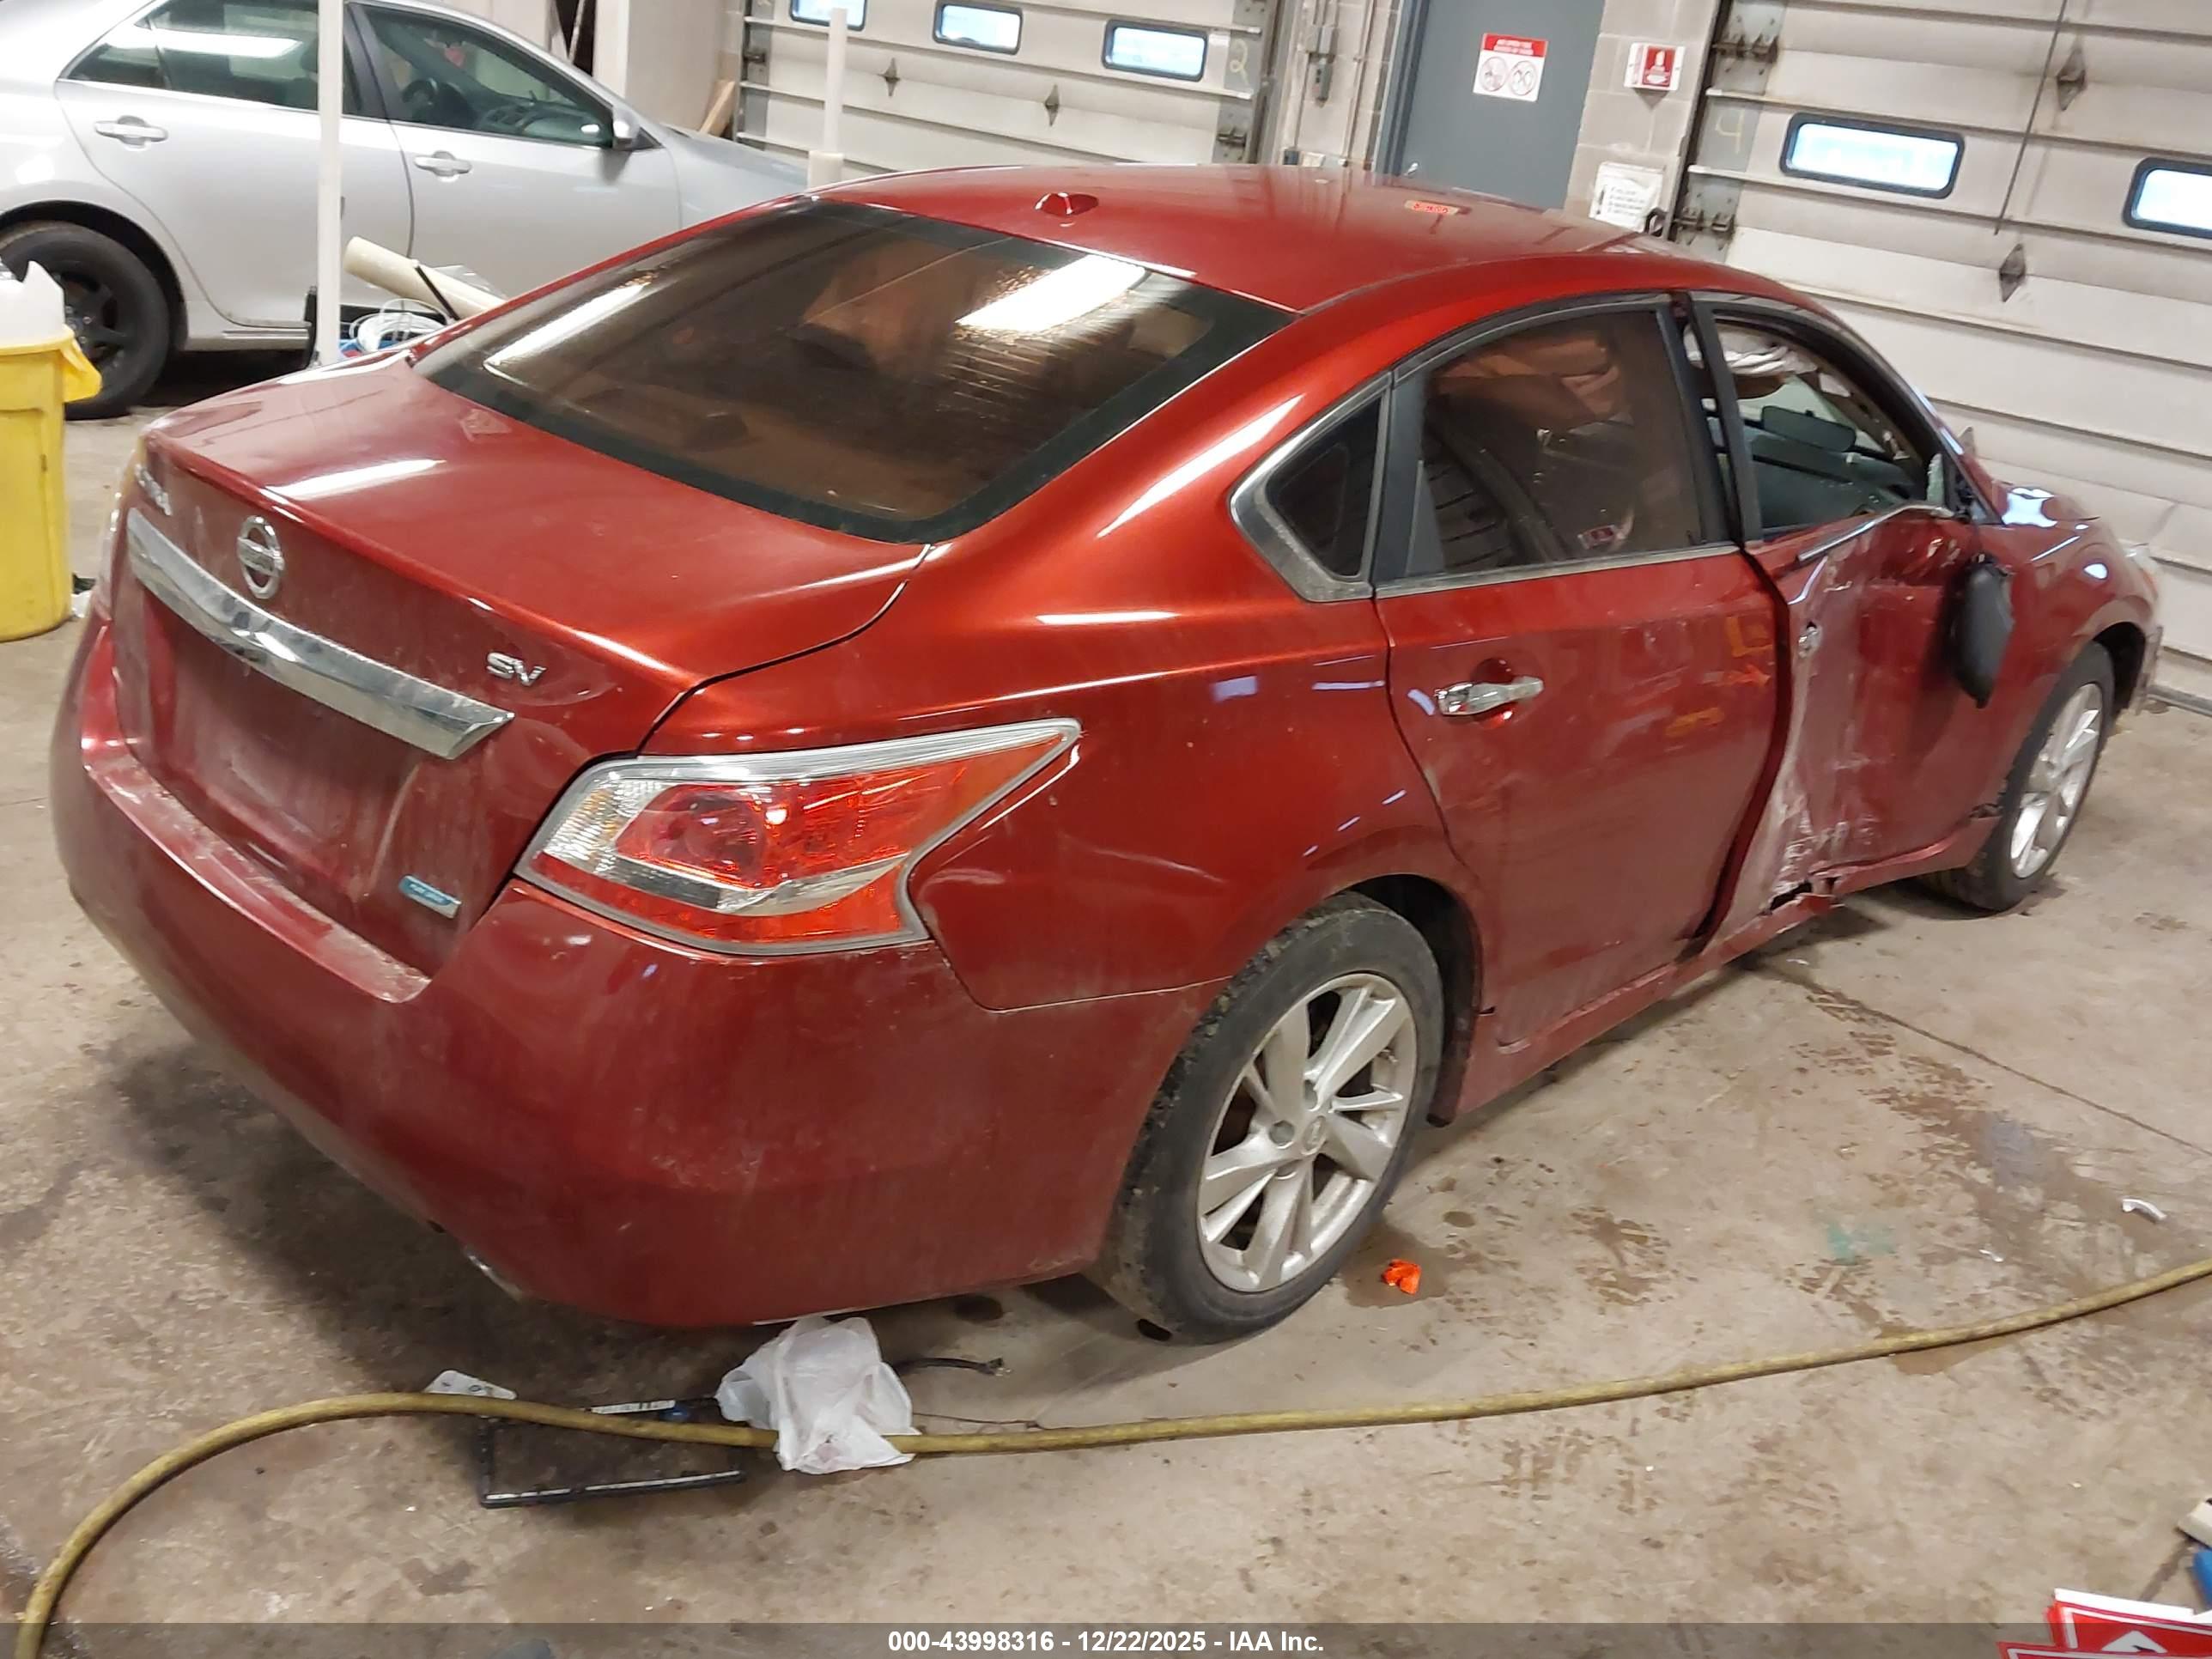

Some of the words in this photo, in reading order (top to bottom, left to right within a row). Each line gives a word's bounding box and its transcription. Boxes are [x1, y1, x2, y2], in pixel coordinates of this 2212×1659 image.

[1229, 38, 1250, 86] 2
[1715, 108, 1745, 155] 4
[486, 652, 548, 687] SV
